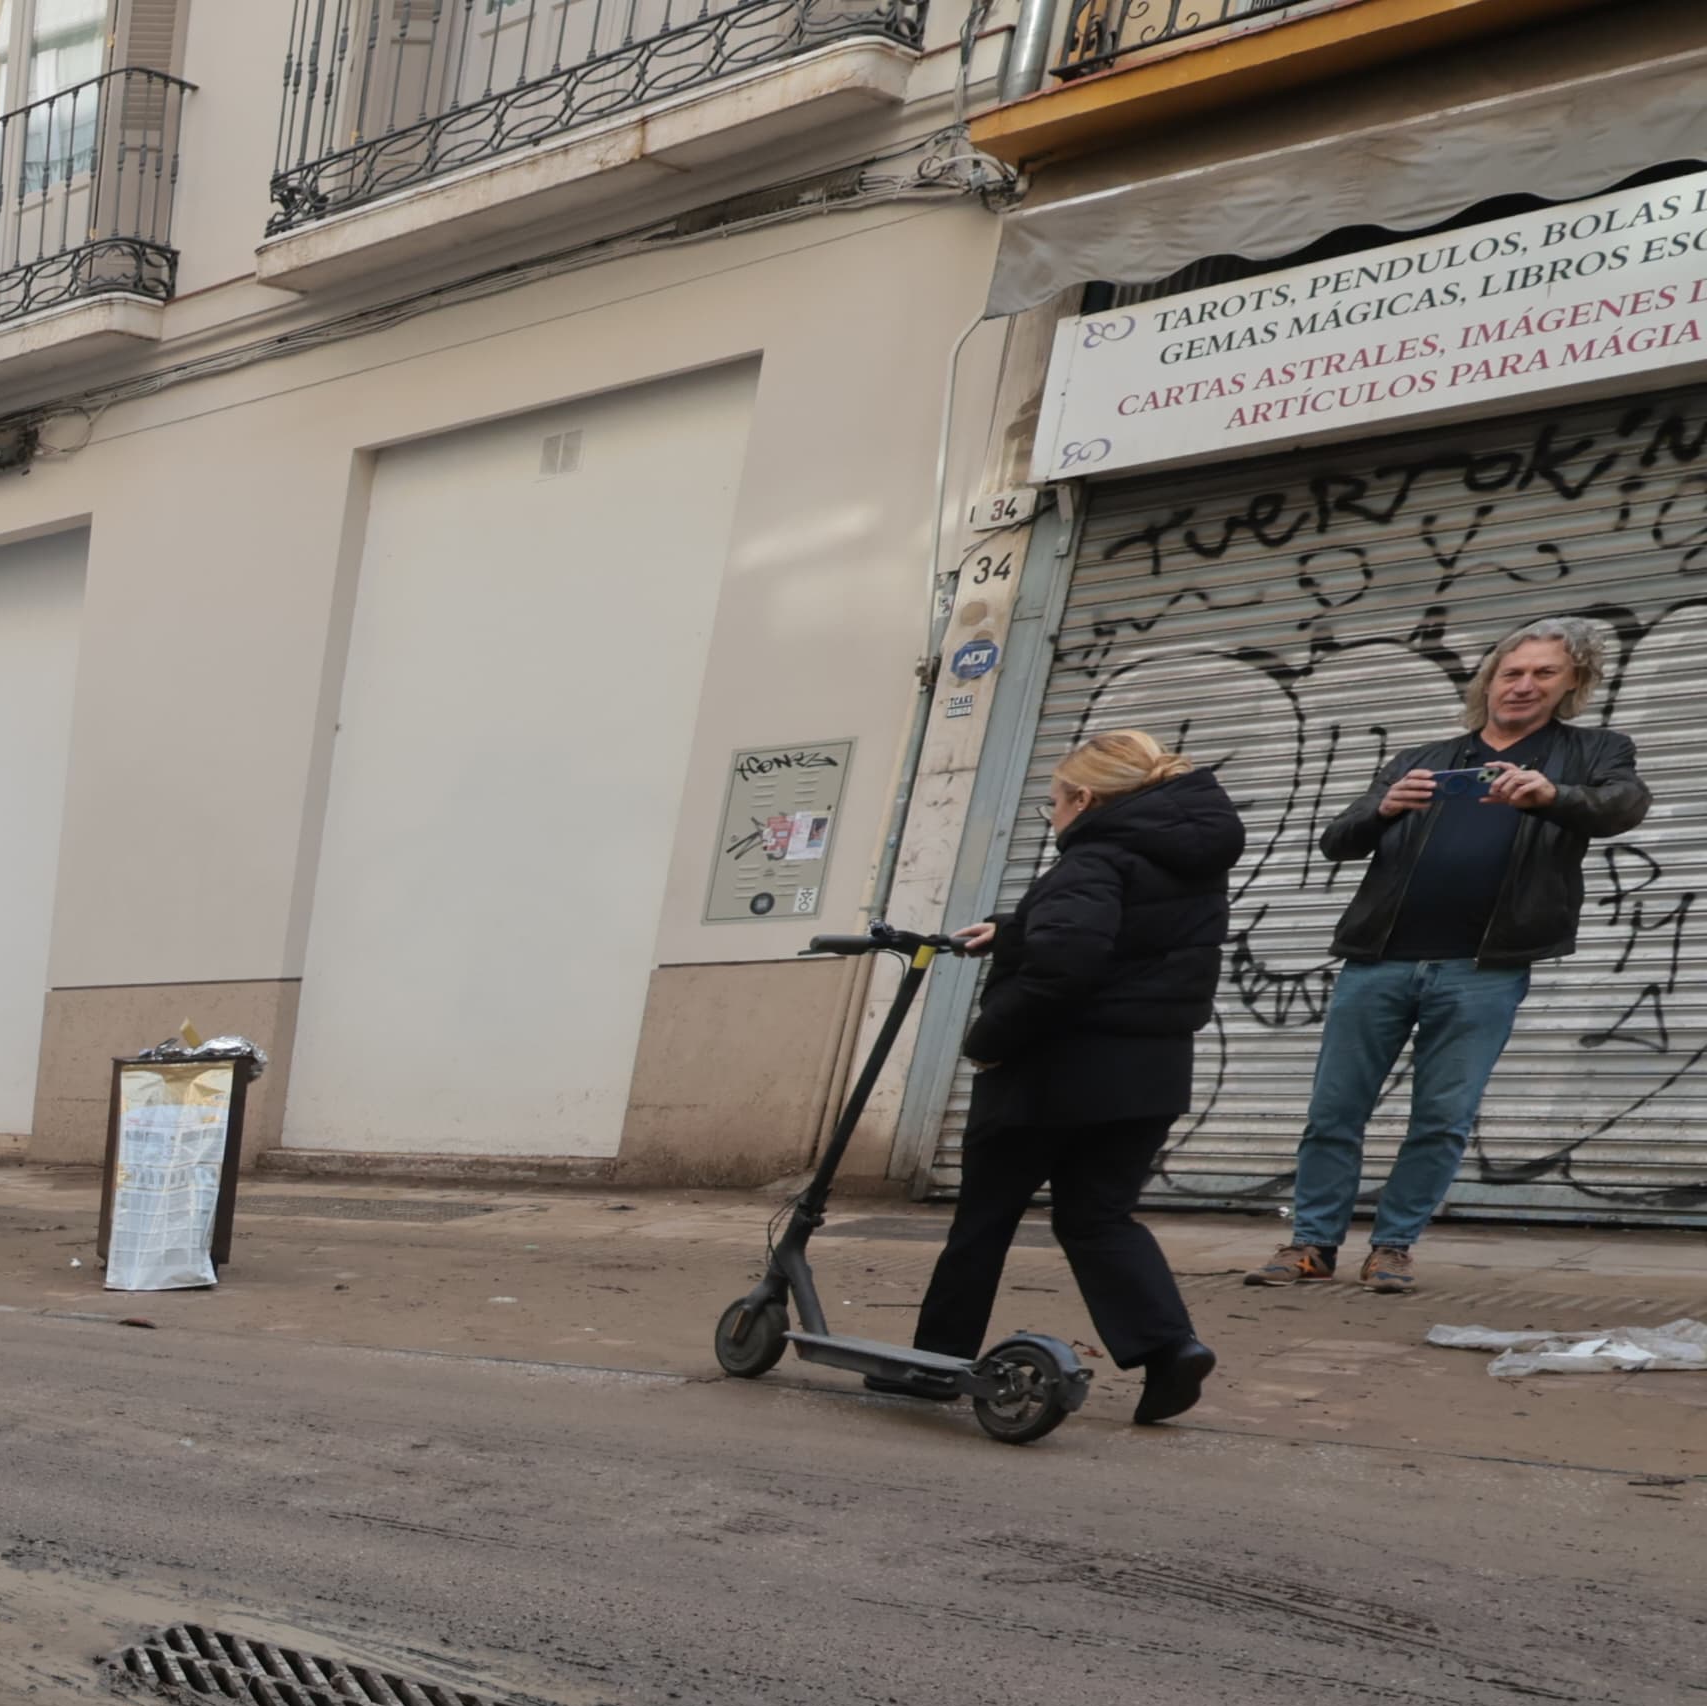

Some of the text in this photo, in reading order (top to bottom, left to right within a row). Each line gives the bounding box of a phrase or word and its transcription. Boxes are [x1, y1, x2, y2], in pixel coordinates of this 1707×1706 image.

[1154, 283, 1297, 334] TAROTS,
[1307, 231, 1529, 299] PENDULOS,
[1539, 195, 1682, 247] BOLAS
[1160, 321, 1279, 365] GEMAS
[1287, 281, 1467, 340] MÁGICAS,
[1478, 245, 1630, 298] LIBROS
[1117, 373, 1247, 417] CARTAS
[1253, 333, 1447, 391] ASTRALES,
[1458, 285, 1678, 349] IMÁGENES
[1224, 319, 1702, 430] ARTÍCULOS PARA MÁGIA
[990, 497, 1018, 522] 34
[974, 552, 1012, 585] 34
[957, 649, 993, 667] ADT
